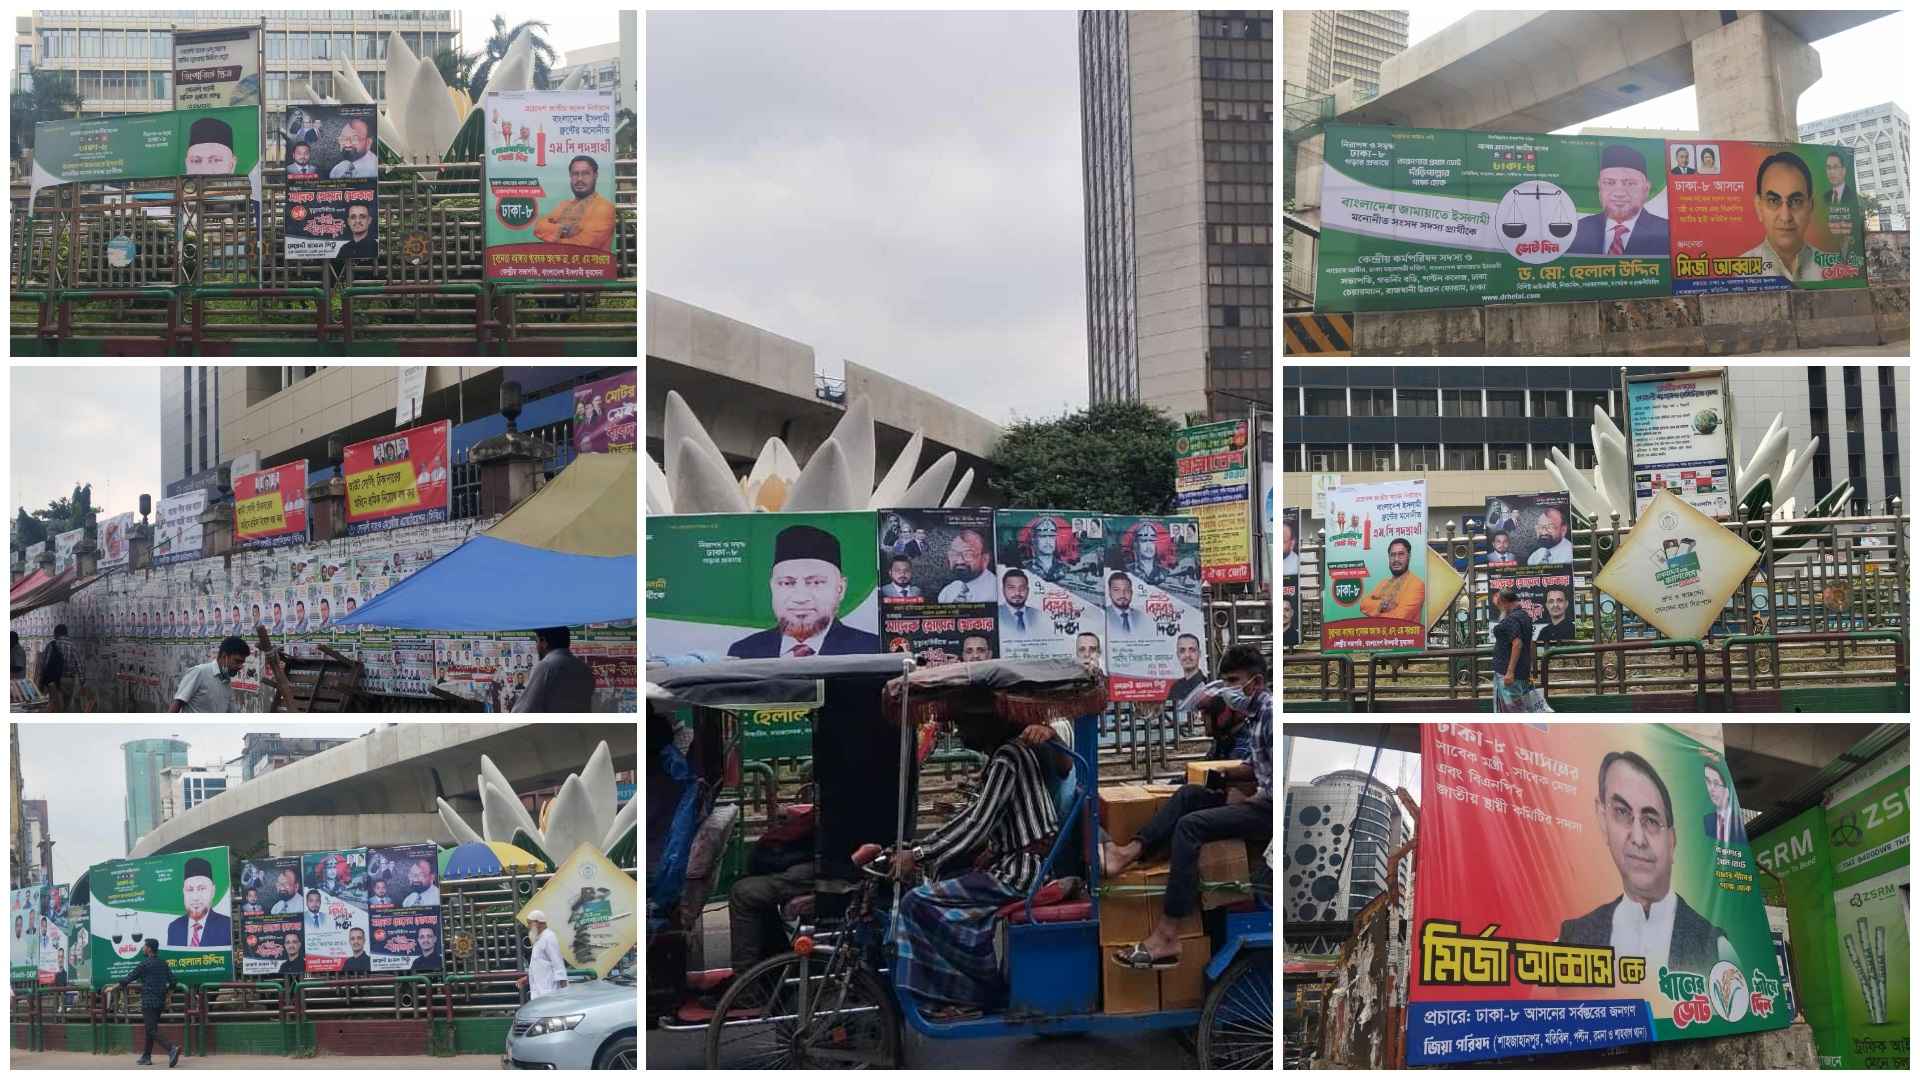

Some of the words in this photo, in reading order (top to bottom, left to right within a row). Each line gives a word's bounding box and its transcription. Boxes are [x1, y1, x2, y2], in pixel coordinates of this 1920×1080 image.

[1350, 149, 1385, 158] ঢাকা-৮
[1674, 181, 1710, 192] ঢাকা-৮
[1713, 181, 1744, 192] আসনে
[500, 204, 533, 218] ঢাকা-৮
[1341, 197, 1395, 213] বাংলাদেশ
[1396, 203, 1449, 220] জামায়াতে
[1451, 207, 1490, 225] ইসলামী
[1351, 212, 1389, 225] মনোনীত
[1391, 218, 1417, 229] সংসদ
[1419, 222, 1444, 232] সদস্য
[1445, 223, 1477, 236] প্রার্থীকে
[1358, 252, 1390, 264] কেন্দ্রীয়
[1515, 240, 1541, 256] ভোট
[1541, 240, 1560, 254] দিন
[1518, 266, 1535, 281] ড.
[1569, 263, 1616, 279] হেলাল
[1619, 260, 1660, 277] উদ্দিন
[1676, 251, 1709, 277] মির্জা
[1713, 256, 1762, 277] আব্বাস
[1336, 584, 1360, 597] ঢাকা-৮
[1435, 739, 1477, 763] সাবেক
[1512, 766, 1549, 785] সাবেক
[1437, 723, 1505, 753] ঢাকা-৮
[1515, 746, 1579, 779] আসনের
[1437, 763, 1464, 782] এবং
[1435, 782, 1479, 806] জাতীয়
[1512, 803, 1552, 824] কমিটির
[1556, 817, 1583, 833] সদস্য
[1862, 785, 1910, 830] ZS
[1757, 828, 1814, 873] SRM
[1862, 883, 1896, 901] ZSRM
[179, 956, 202, 967] হেলাল
[203, 953, 224, 965] উদ্দিন
[1422, 921, 1510, 984] মির্জা
[1515, 942, 1614, 986] আব্বাস
[1619, 956, 1646, 984] কে
[1659, 966, 1706, 1001] ধানের
[1424, 1009, 1471, 1026] প্রচারে:
[1475, 1008, 1519, 1023] ঢাকা-৮
[1524, 1007, 1565, 1021] আসনের
[1569, 1002, 1606, 1019] সর্বস্তরের
[1609, 1005, 1636, 1018] জনগণ
[1673, 993, 1713, 1029] ভোট
[1750, 991, 1774, 1018] দিন
[1424, 1036, 1452, 1056] জিয়া
[1456, 1032, 1490, 1053] পরিষদ
